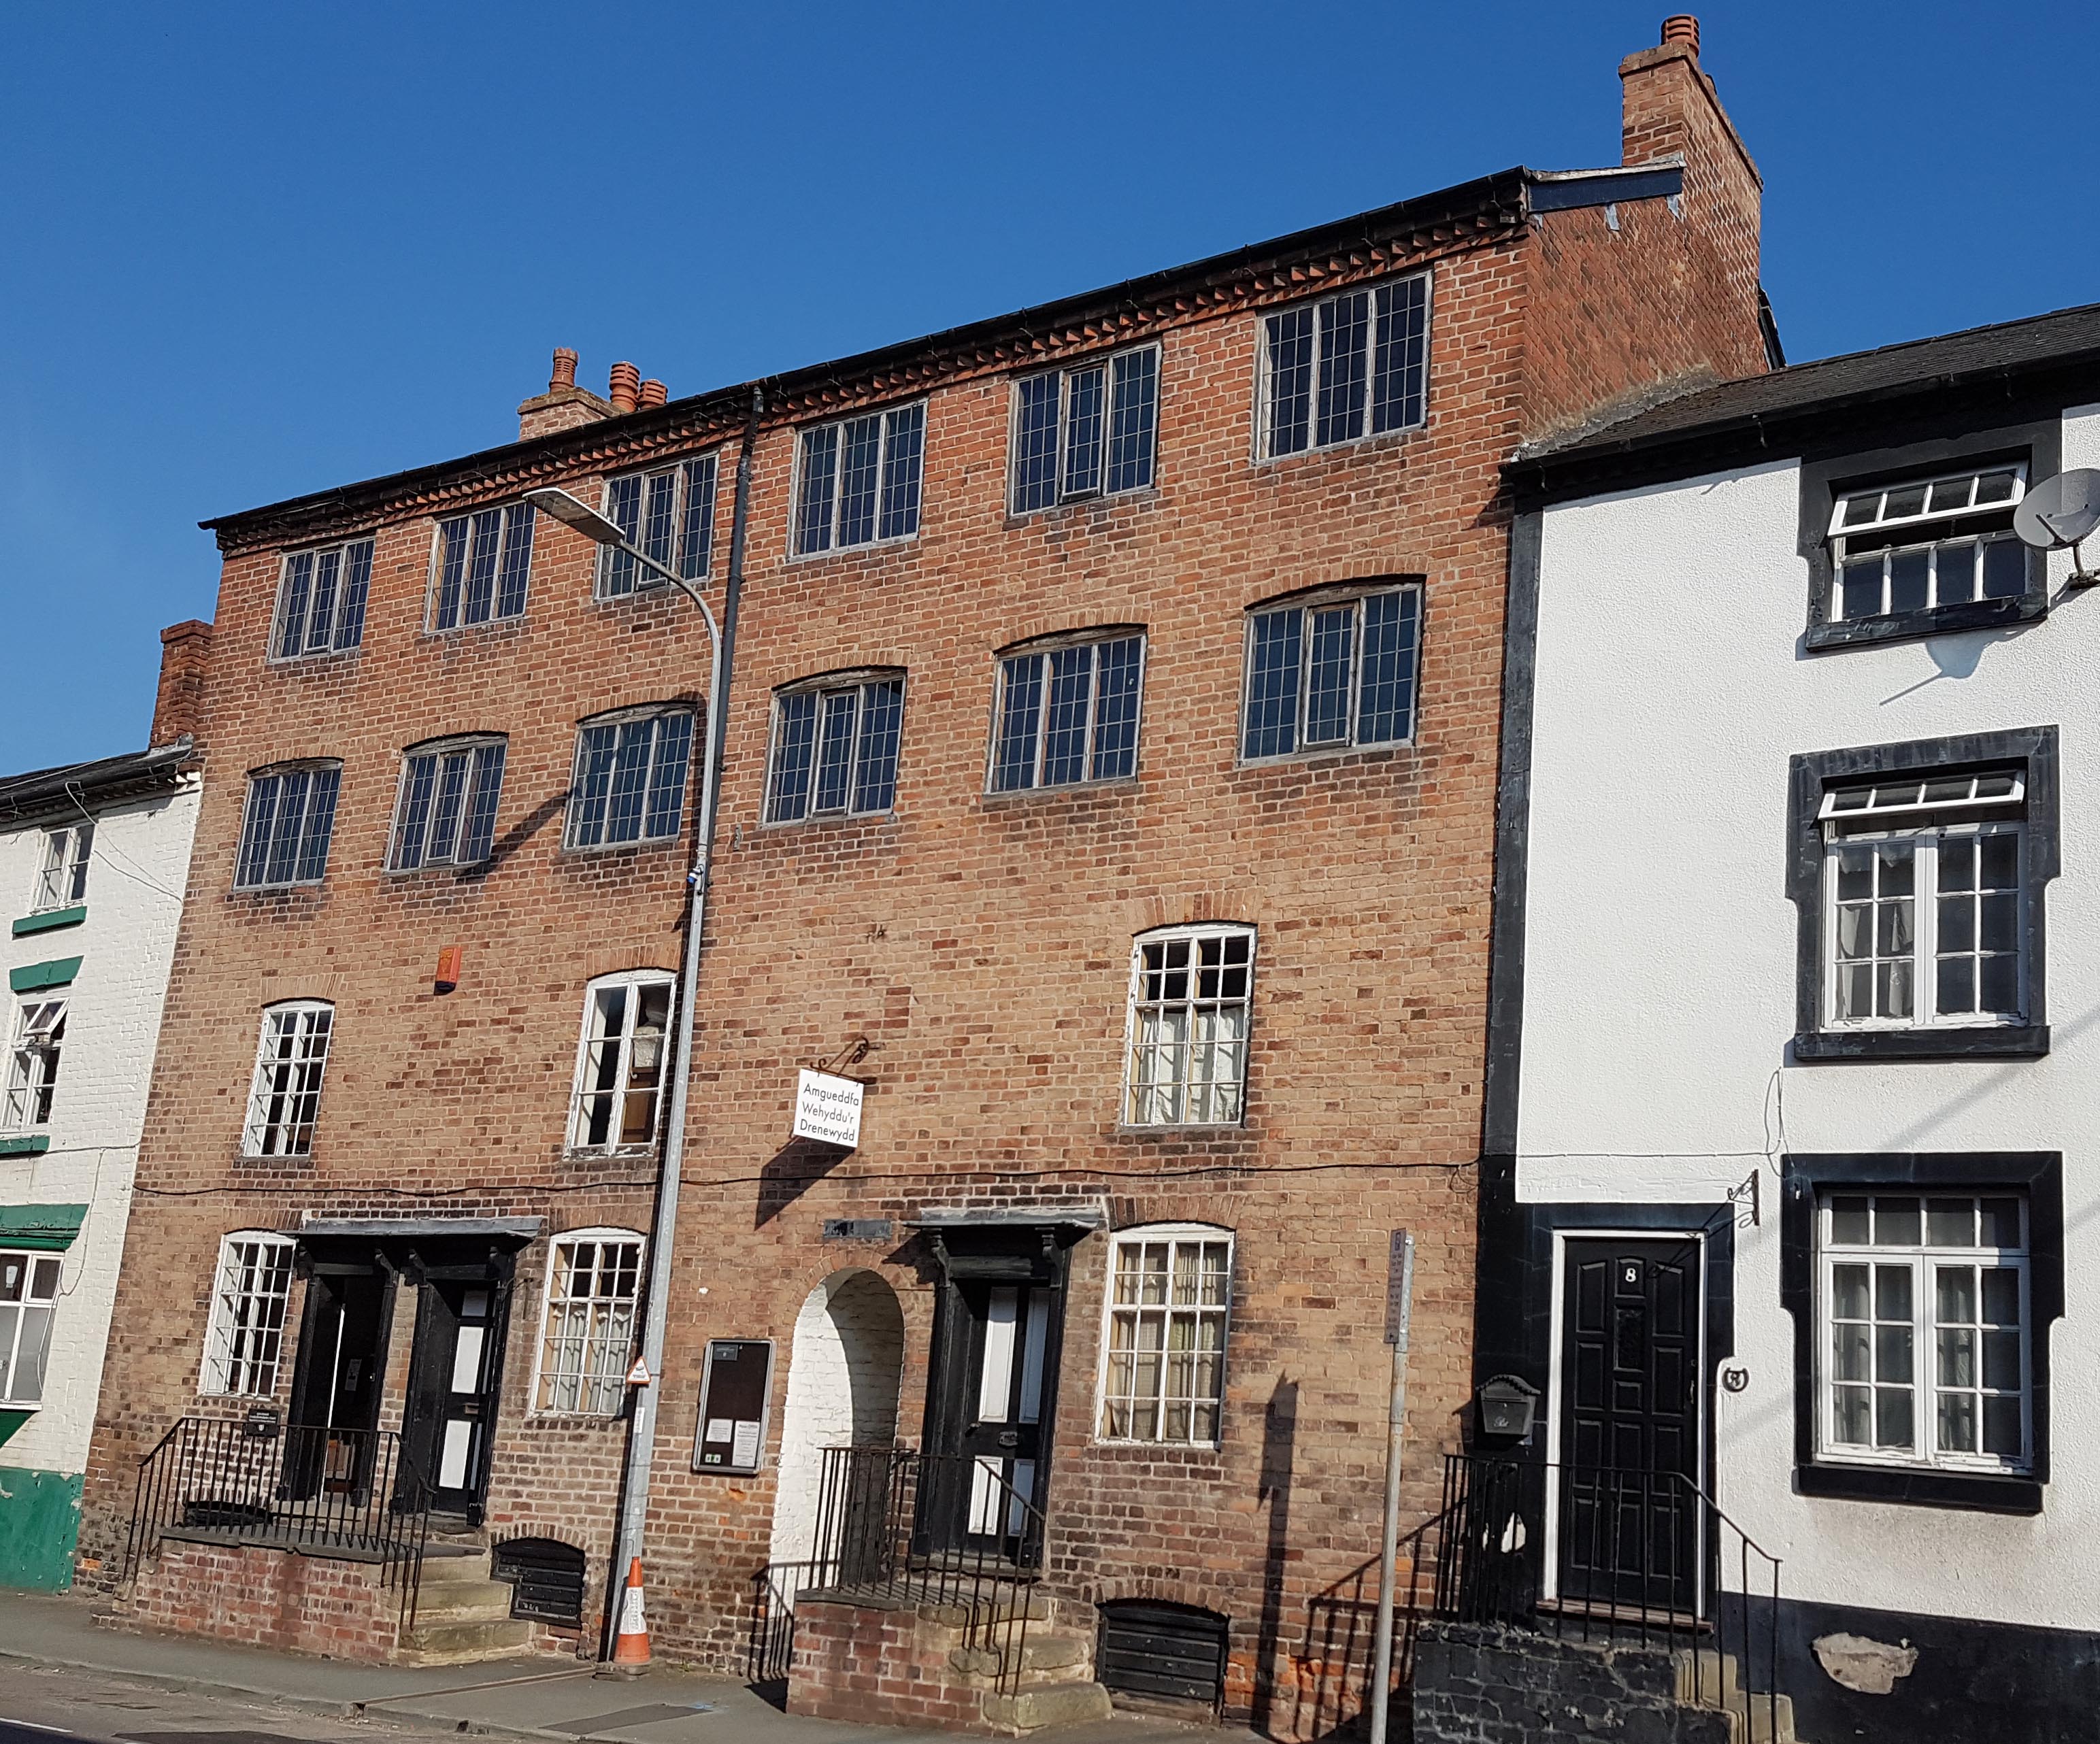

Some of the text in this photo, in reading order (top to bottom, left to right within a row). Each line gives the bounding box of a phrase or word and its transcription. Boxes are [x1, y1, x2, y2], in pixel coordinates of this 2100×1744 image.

[803, 1084, 859, 1106] Amgueddfa
[803, 1101, 854, 1124] Wehyddu'r
[800, 1119, 855, 1141] Drenewydd
[1624, 1267, 1637, 1283] 8
